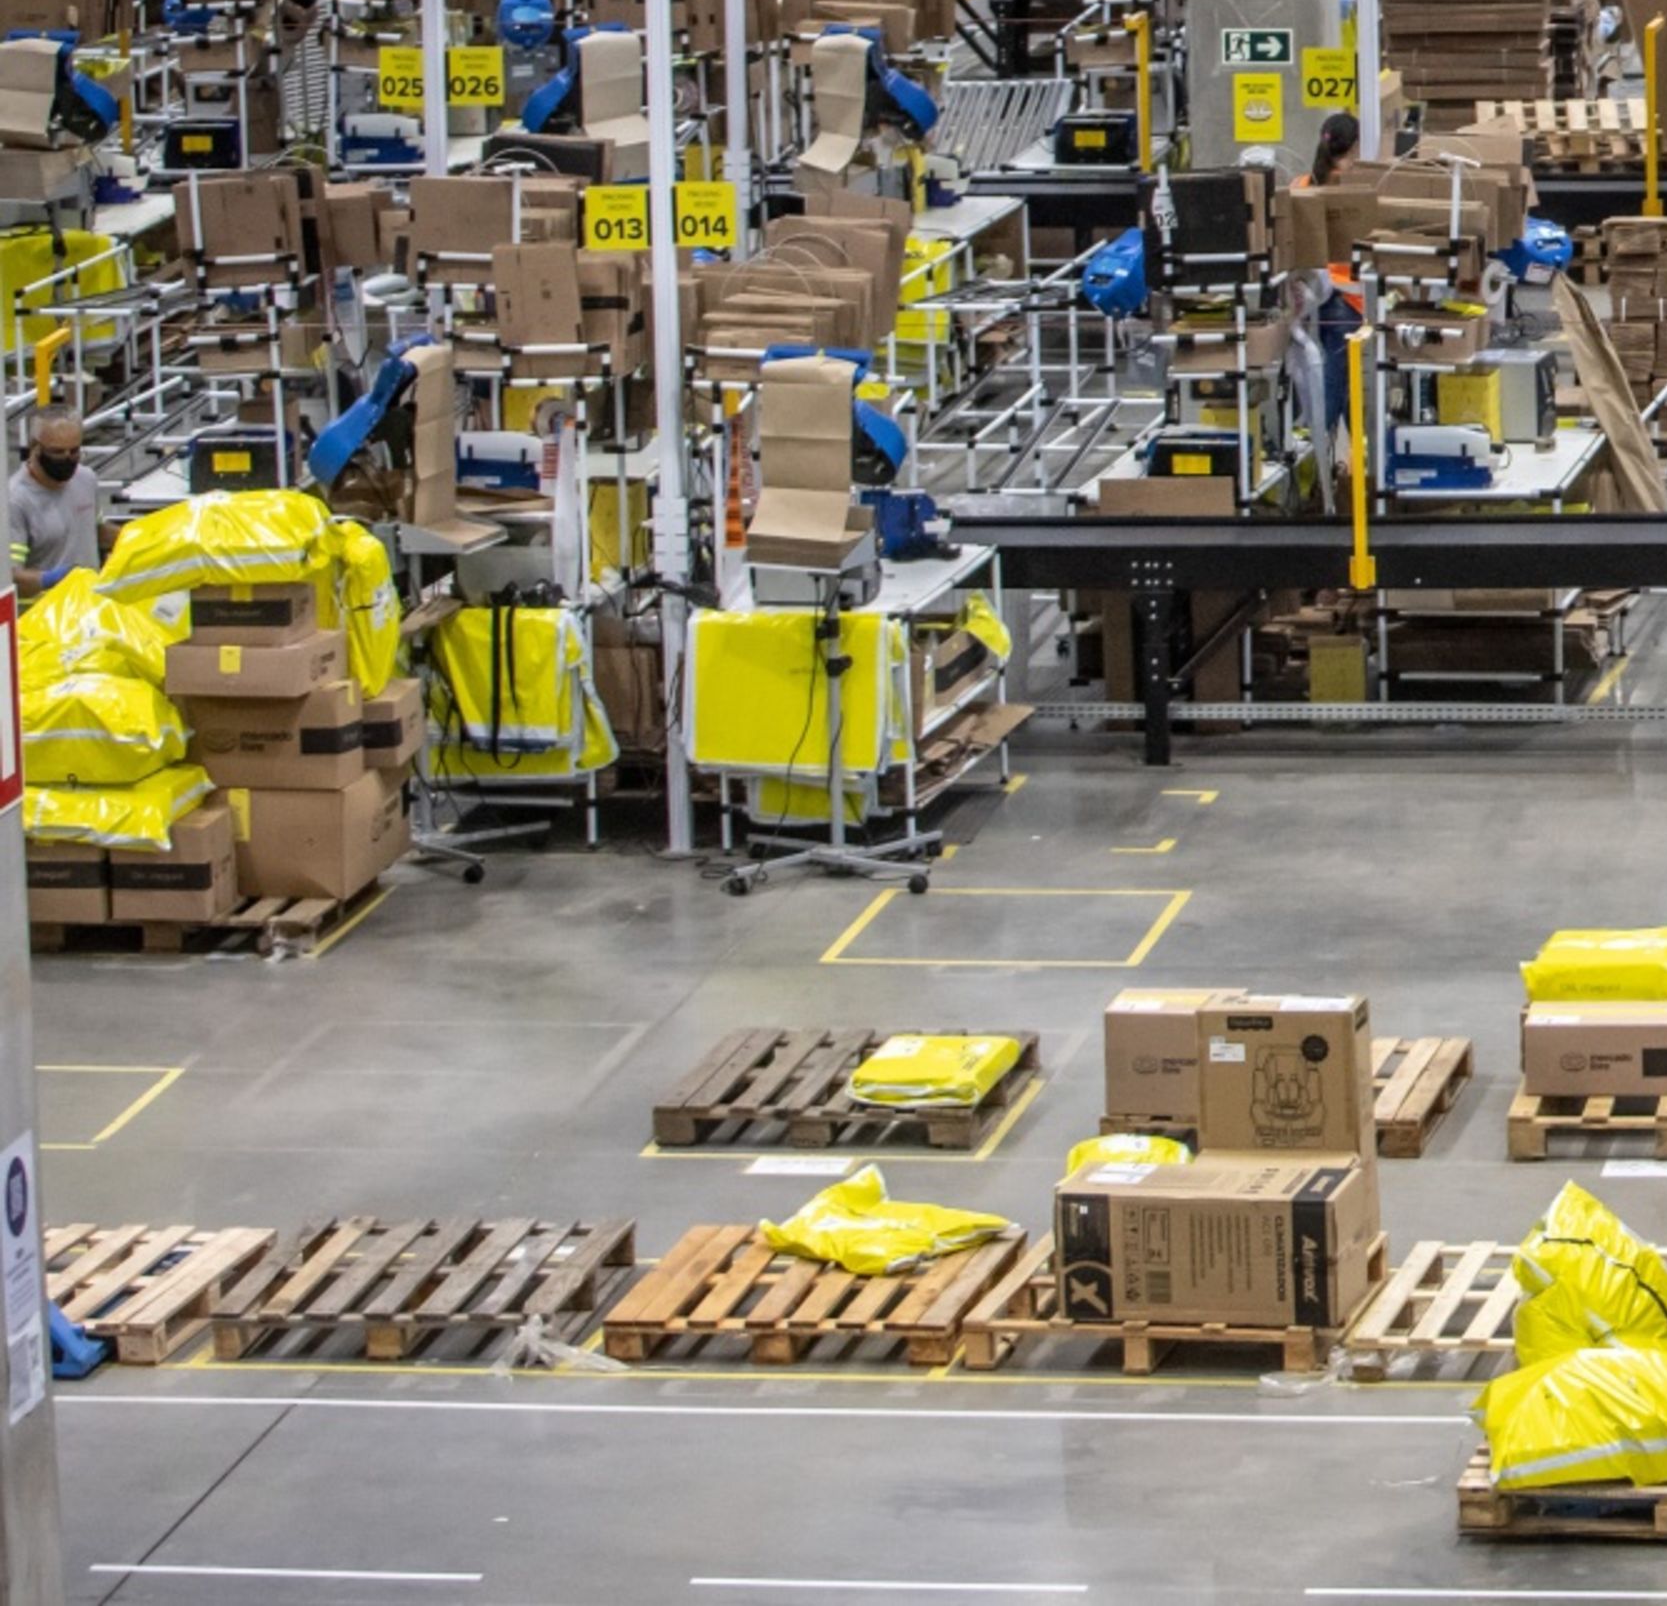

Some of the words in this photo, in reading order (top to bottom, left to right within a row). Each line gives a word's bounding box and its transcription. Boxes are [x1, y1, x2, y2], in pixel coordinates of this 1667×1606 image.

[382, 76, 424, 97] 025
[451, 76, 499, 97] 026
[1307, 77, 1354, 97] 027
[594, 218, 643, 240] 013
[681, 215, 728, 237] 014
[239, 731, 292, 742] mercado
[1161, 1057, 1198, 1067] mercad
[1590, 1052, 1633, 1063] mercado
[1274, 1215, 1286, 1302] CLIMATIZADOR
